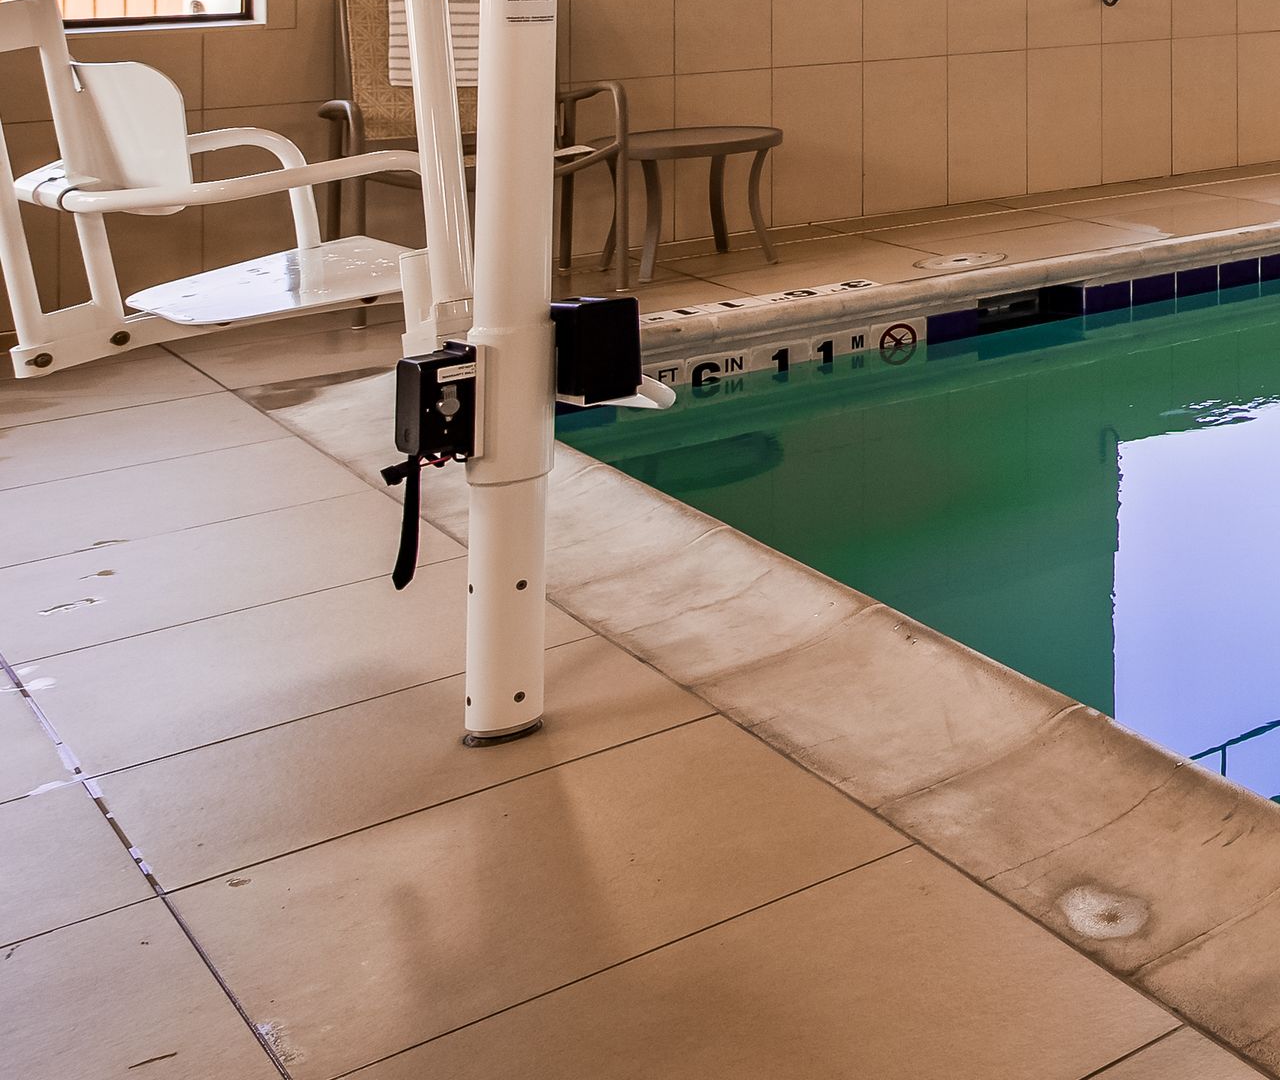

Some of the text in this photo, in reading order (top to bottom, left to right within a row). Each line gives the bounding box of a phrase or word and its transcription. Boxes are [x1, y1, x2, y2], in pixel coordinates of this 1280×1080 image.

[658, 368, 679, 383] FT
[692, 362, 721, 387] 6
[725, 356, 744, 373] IN
[851, 334, 865, 350] M
